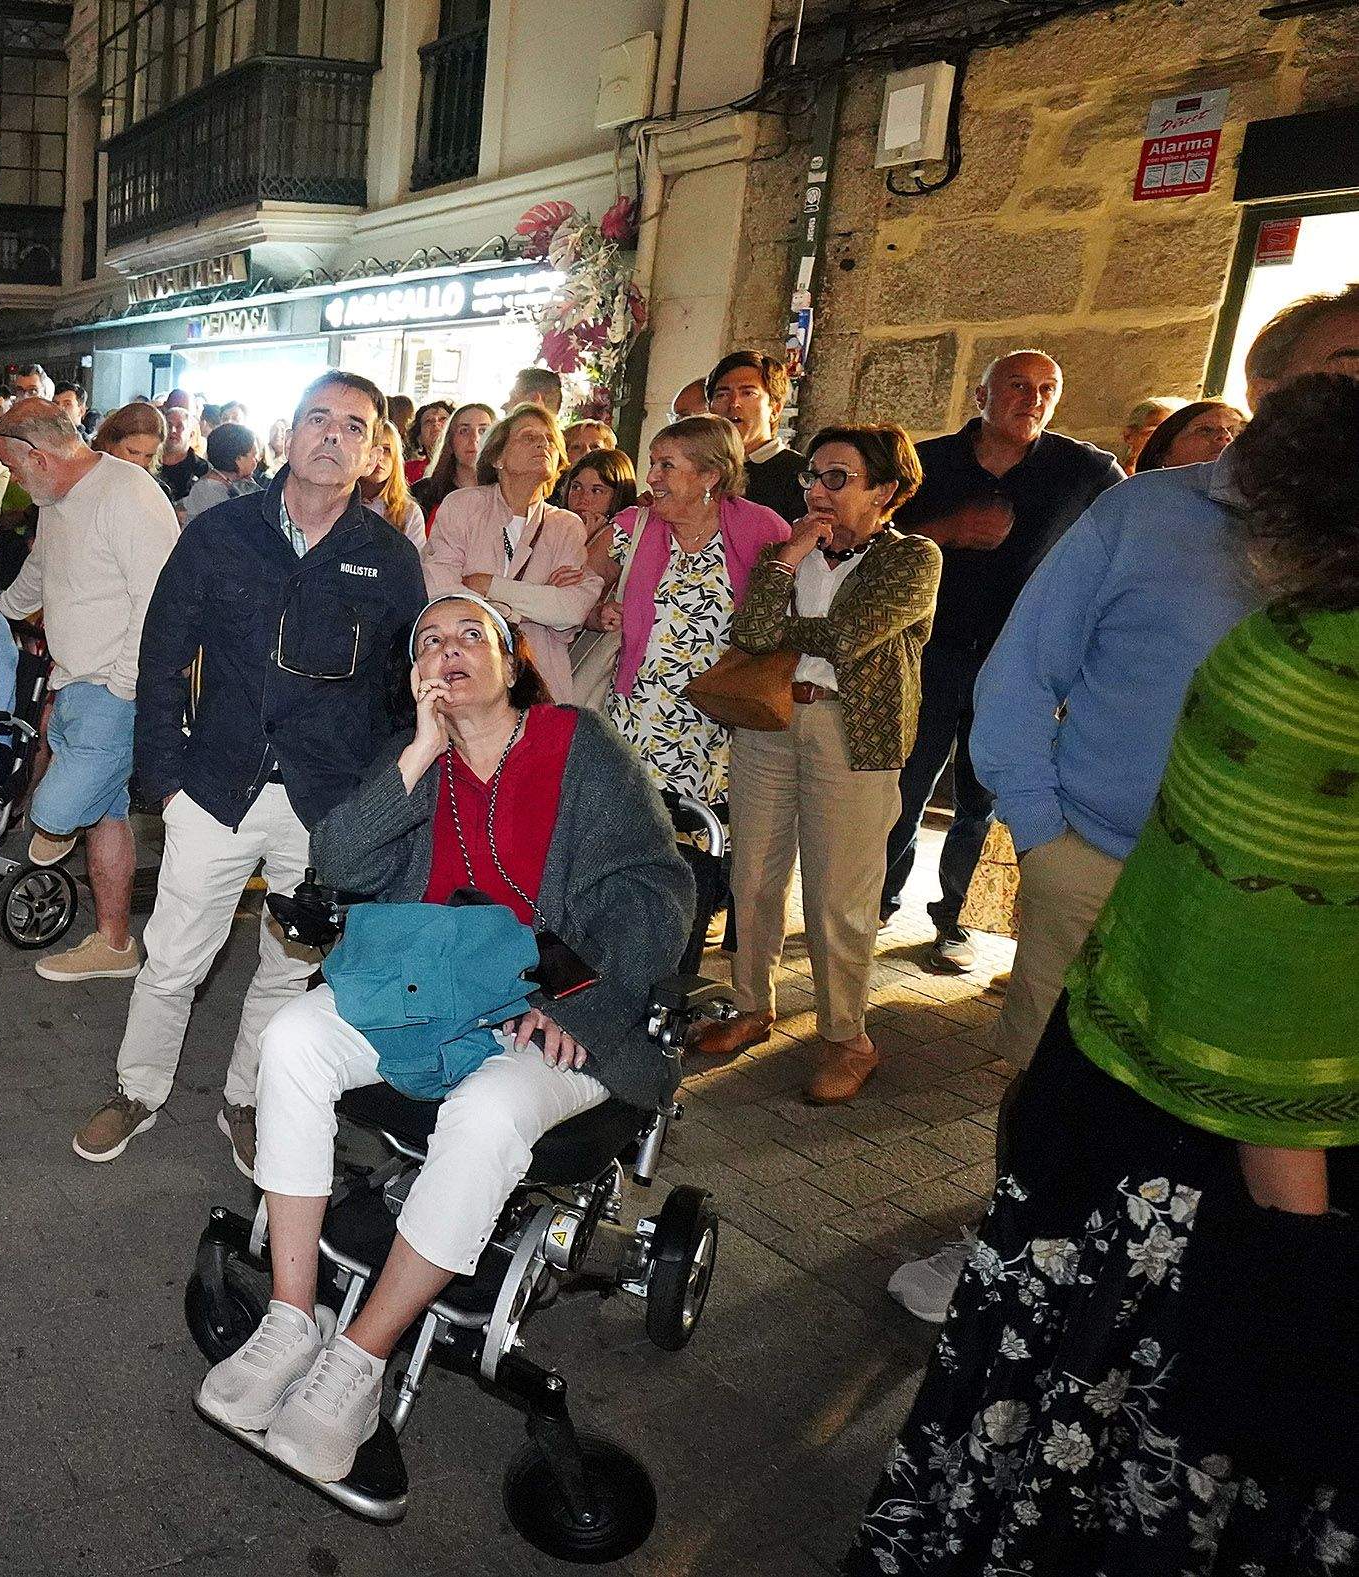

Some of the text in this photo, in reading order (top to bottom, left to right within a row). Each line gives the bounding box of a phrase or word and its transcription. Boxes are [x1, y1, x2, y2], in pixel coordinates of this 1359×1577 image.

[1149, 137, 1213, 155] Alarma
[201, 305, 269, 338] PEDROSA
[340, 563, 378, 577] HOLLISTER
